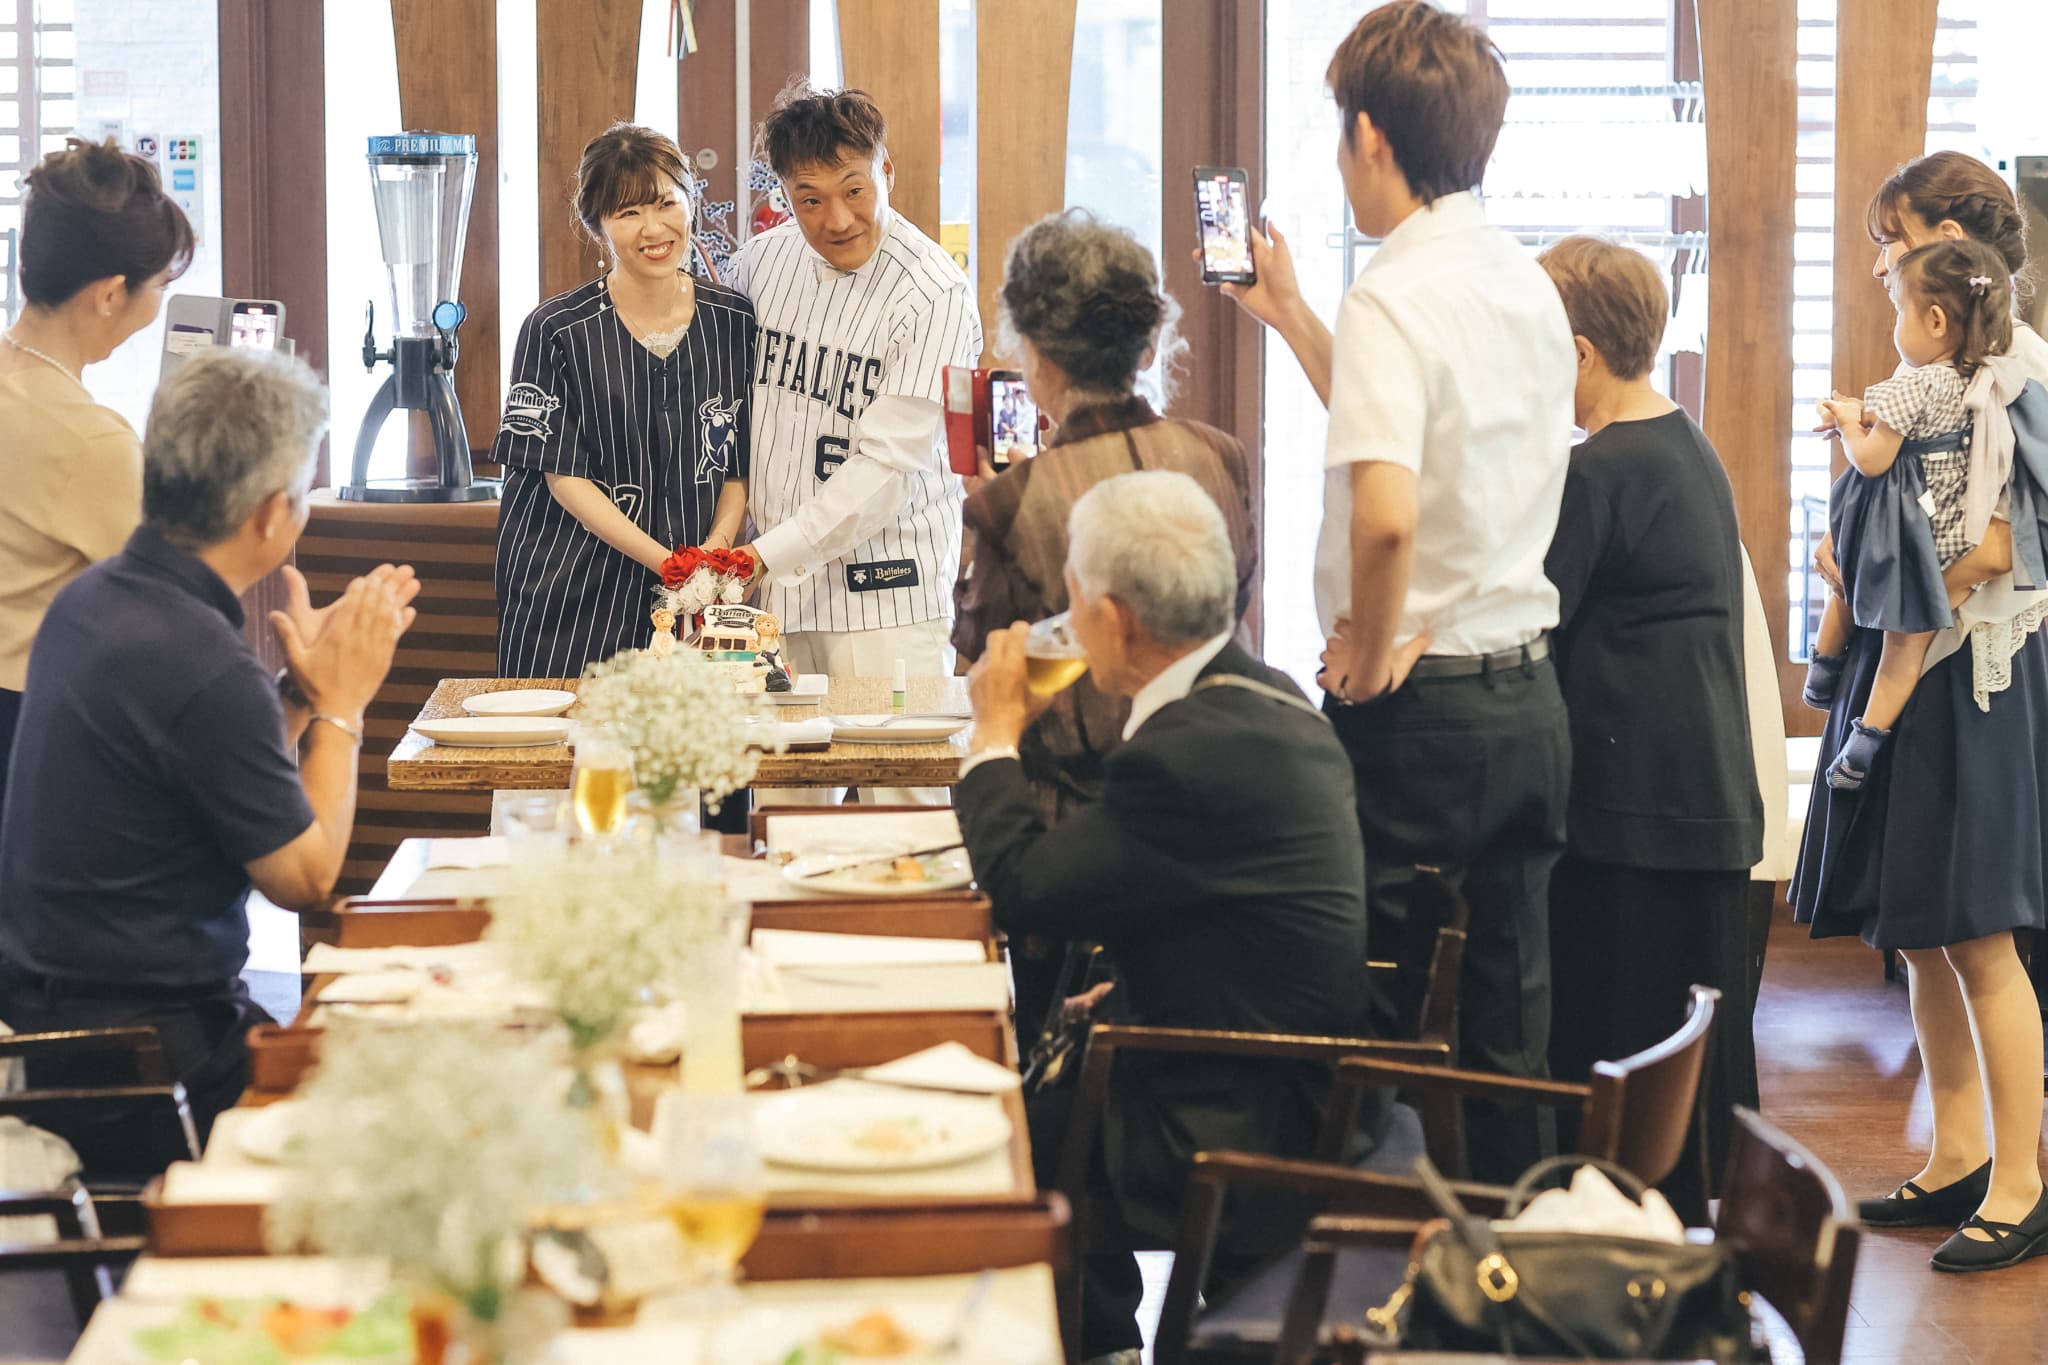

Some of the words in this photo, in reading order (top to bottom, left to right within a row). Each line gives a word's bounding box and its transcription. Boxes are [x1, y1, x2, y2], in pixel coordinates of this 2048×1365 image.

[377, 140, 393, 152] The
[395, 139, 452, 153] PREMIUM
[815, 434, 850, 483] 6
